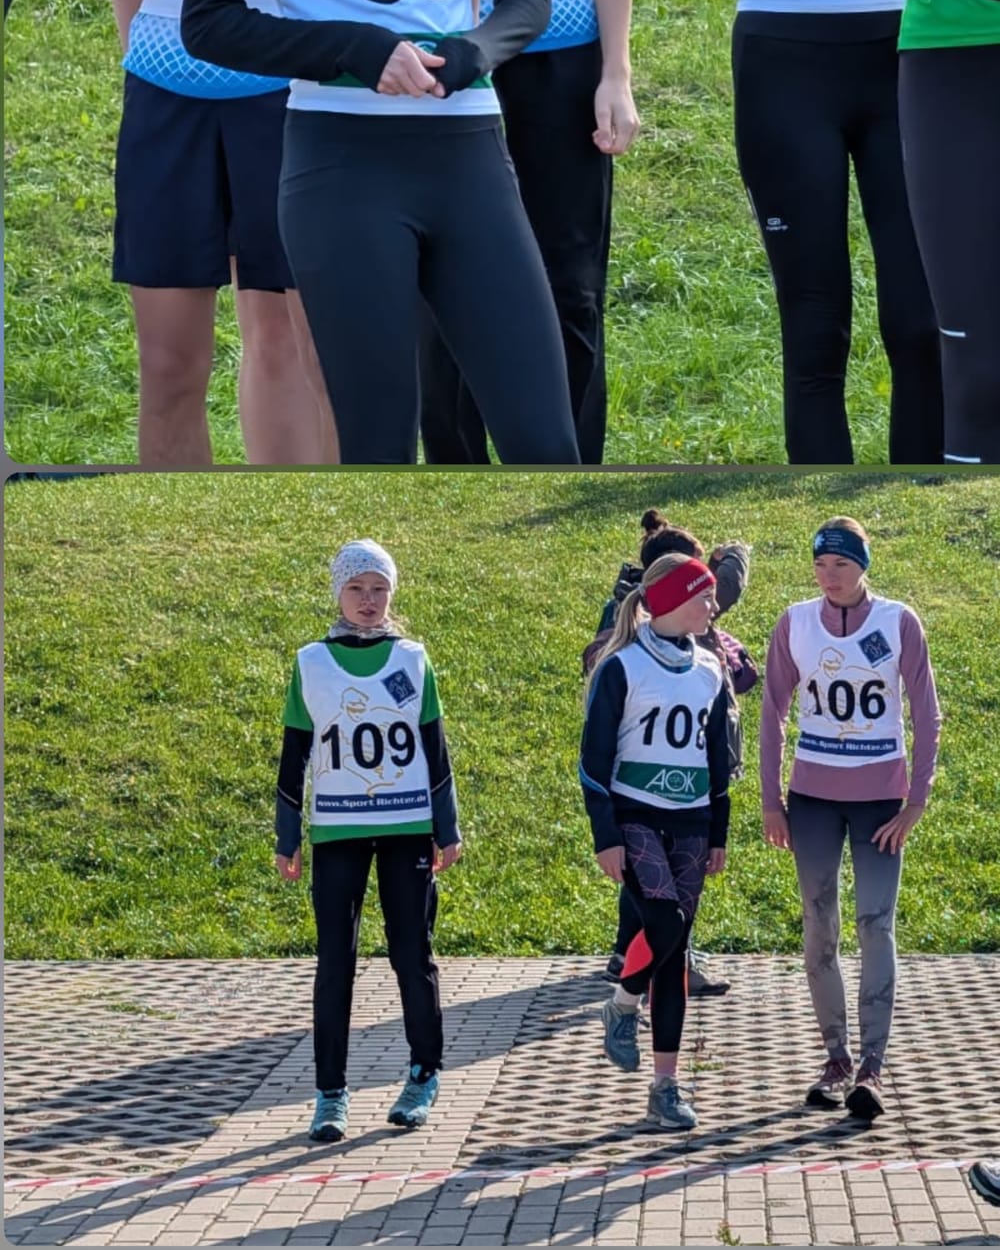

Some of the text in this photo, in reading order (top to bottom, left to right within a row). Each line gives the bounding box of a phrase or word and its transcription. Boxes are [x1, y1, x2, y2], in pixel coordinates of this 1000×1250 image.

[807, 679, 886, 722] 106
[320, 720, 416, 770] 109
[639, 704, 708, 751] 108
[645, 768, 698, 793] AOK
